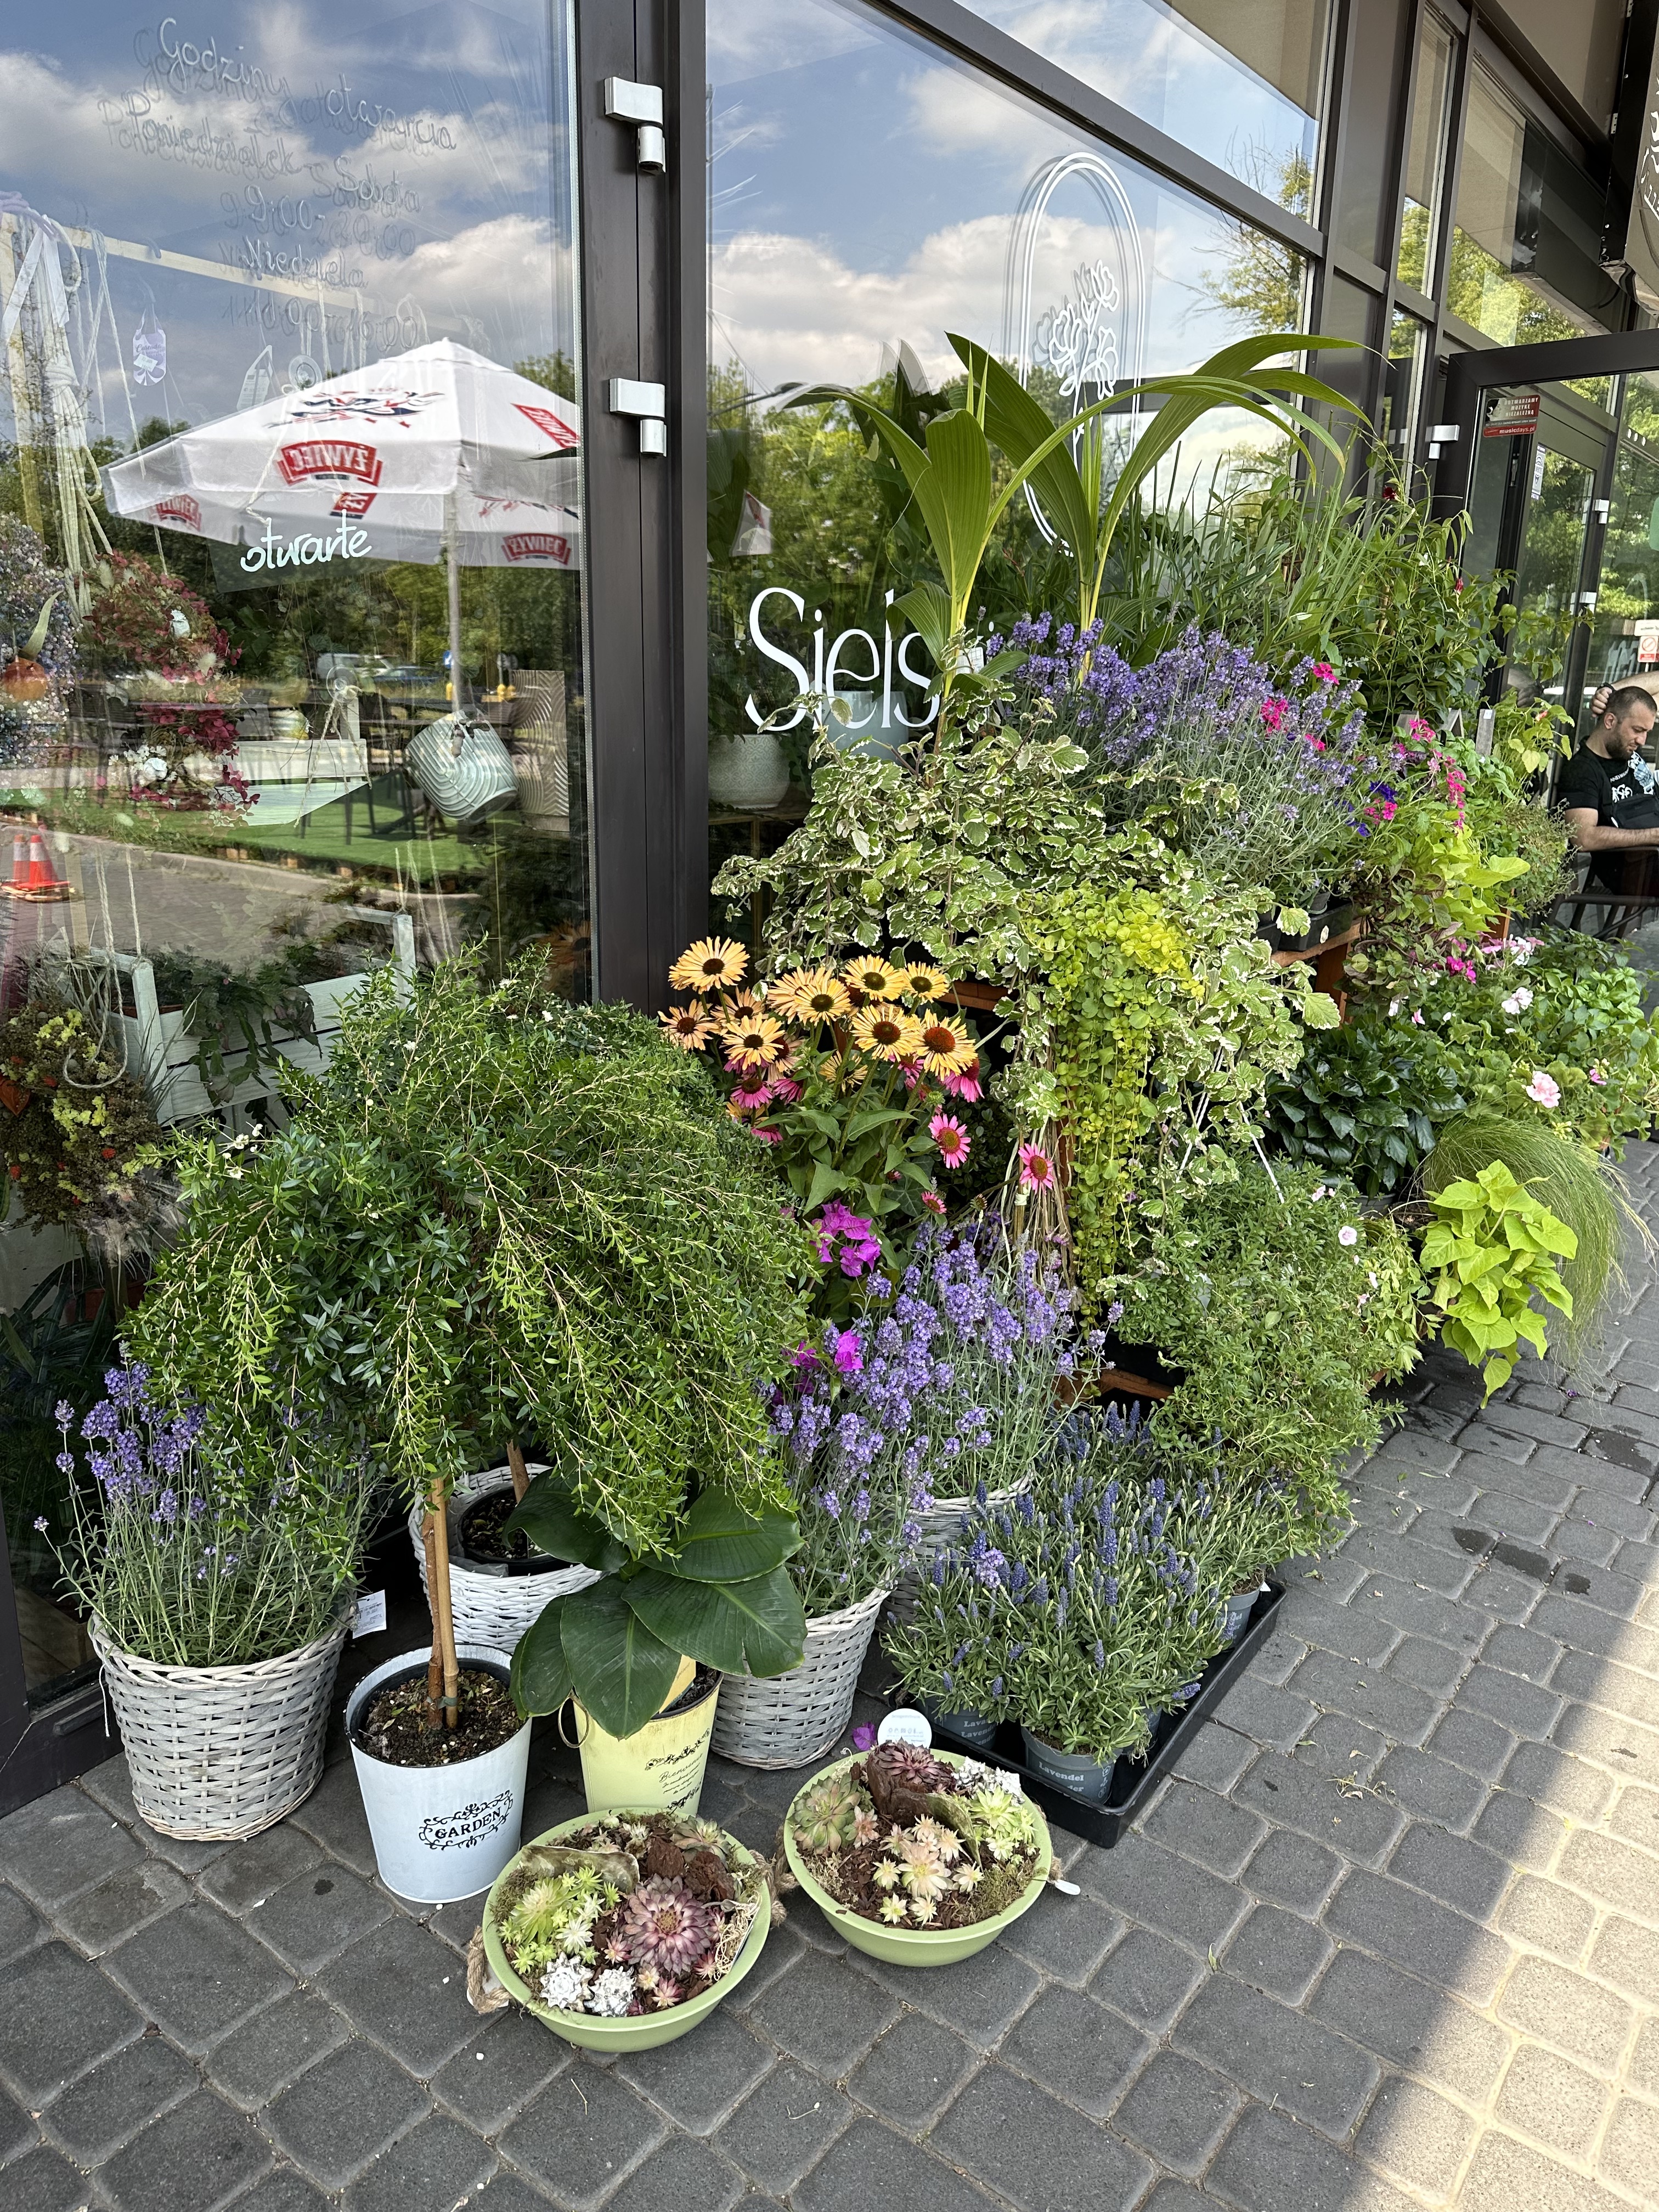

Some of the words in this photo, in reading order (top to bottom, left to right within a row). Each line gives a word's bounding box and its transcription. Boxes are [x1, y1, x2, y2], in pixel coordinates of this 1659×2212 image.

[240, 509, 372, 572] otwarte
[744, 587, 996, 731] Siels
[1039, 1761, 1085, 1781] Lavendel
[435, 1807, 501, 1839] GARDEN
